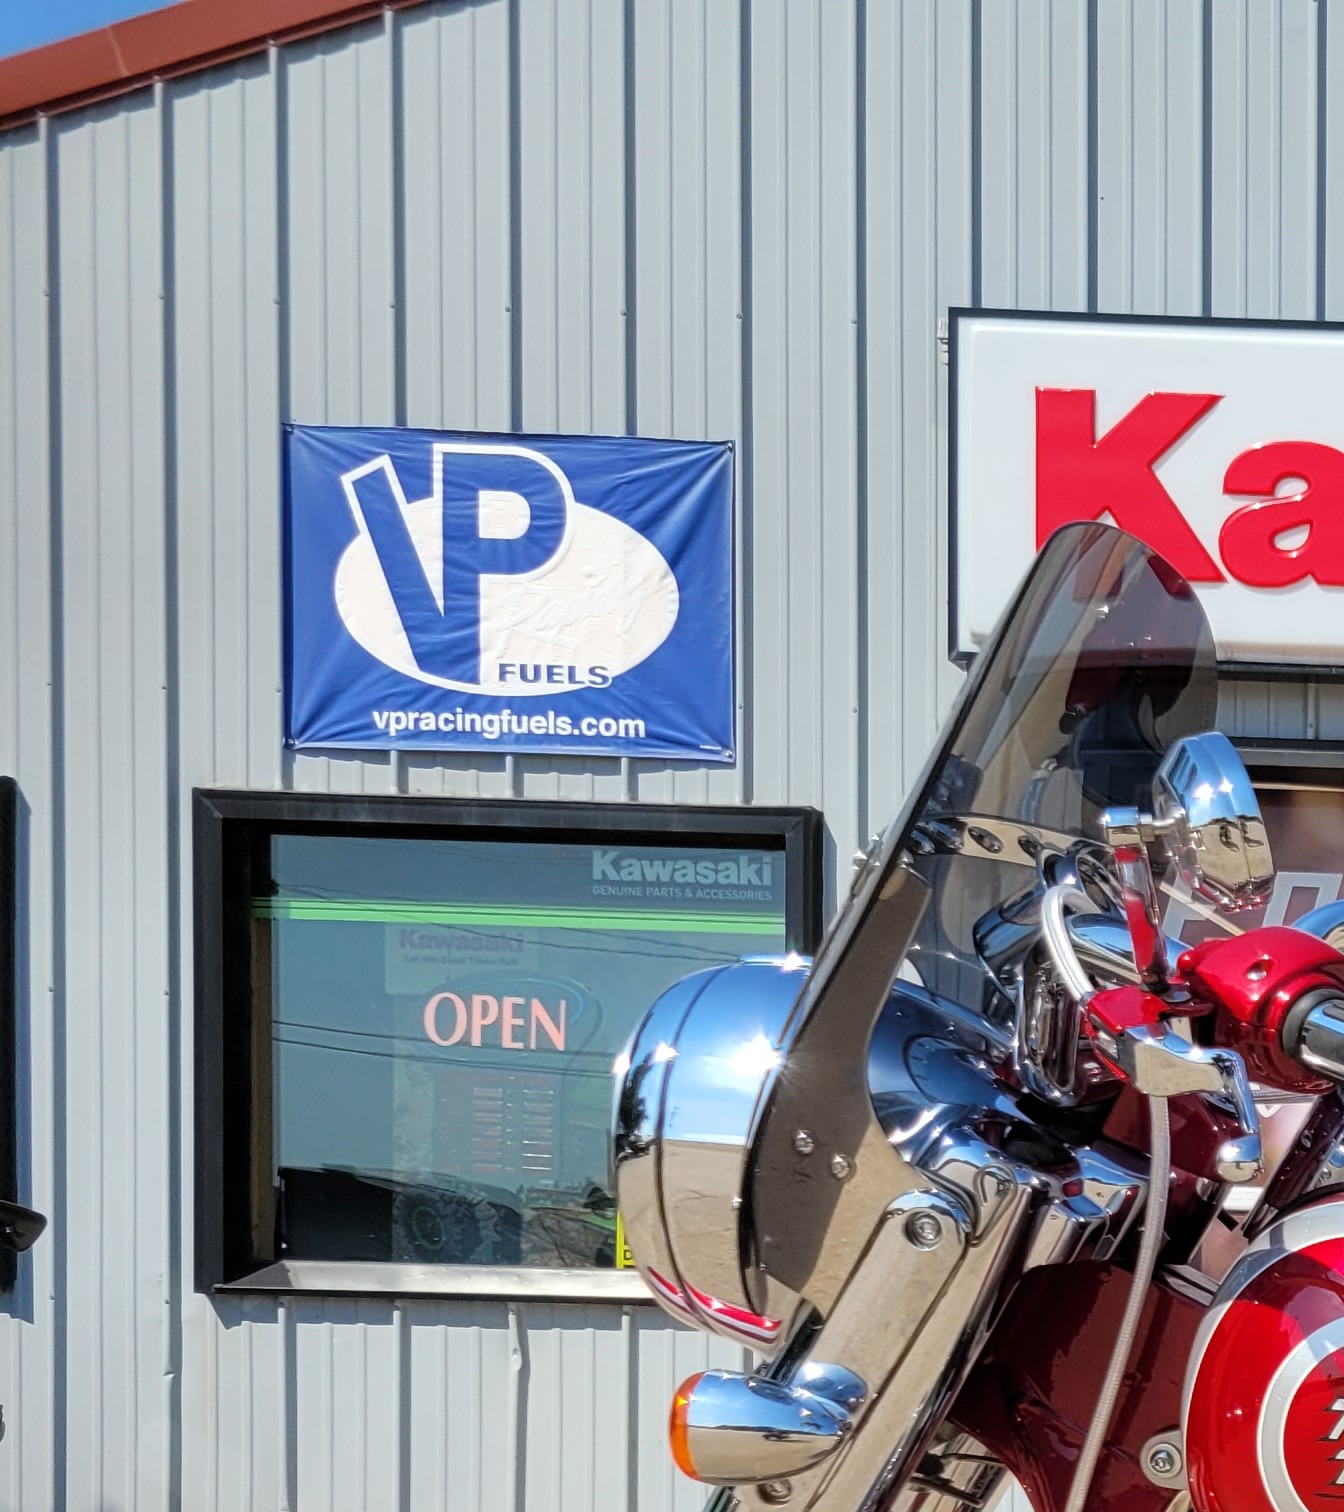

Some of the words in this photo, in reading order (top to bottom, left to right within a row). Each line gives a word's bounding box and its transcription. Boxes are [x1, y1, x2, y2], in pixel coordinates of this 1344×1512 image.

[341, 443, 575, 686] VP
[498, 662, 610, 687] FUELS
[373, 708, 646, 739] vpracingfuels.com
[592, 850, 772, 886] Kawasaki
[592, 885, 643, 897] GENUINE
[646, 887, 682, 898] PARTS
[695, 889, 772, 900] ACCESSORIES
[423, 991, 567, 1051] OPEN
